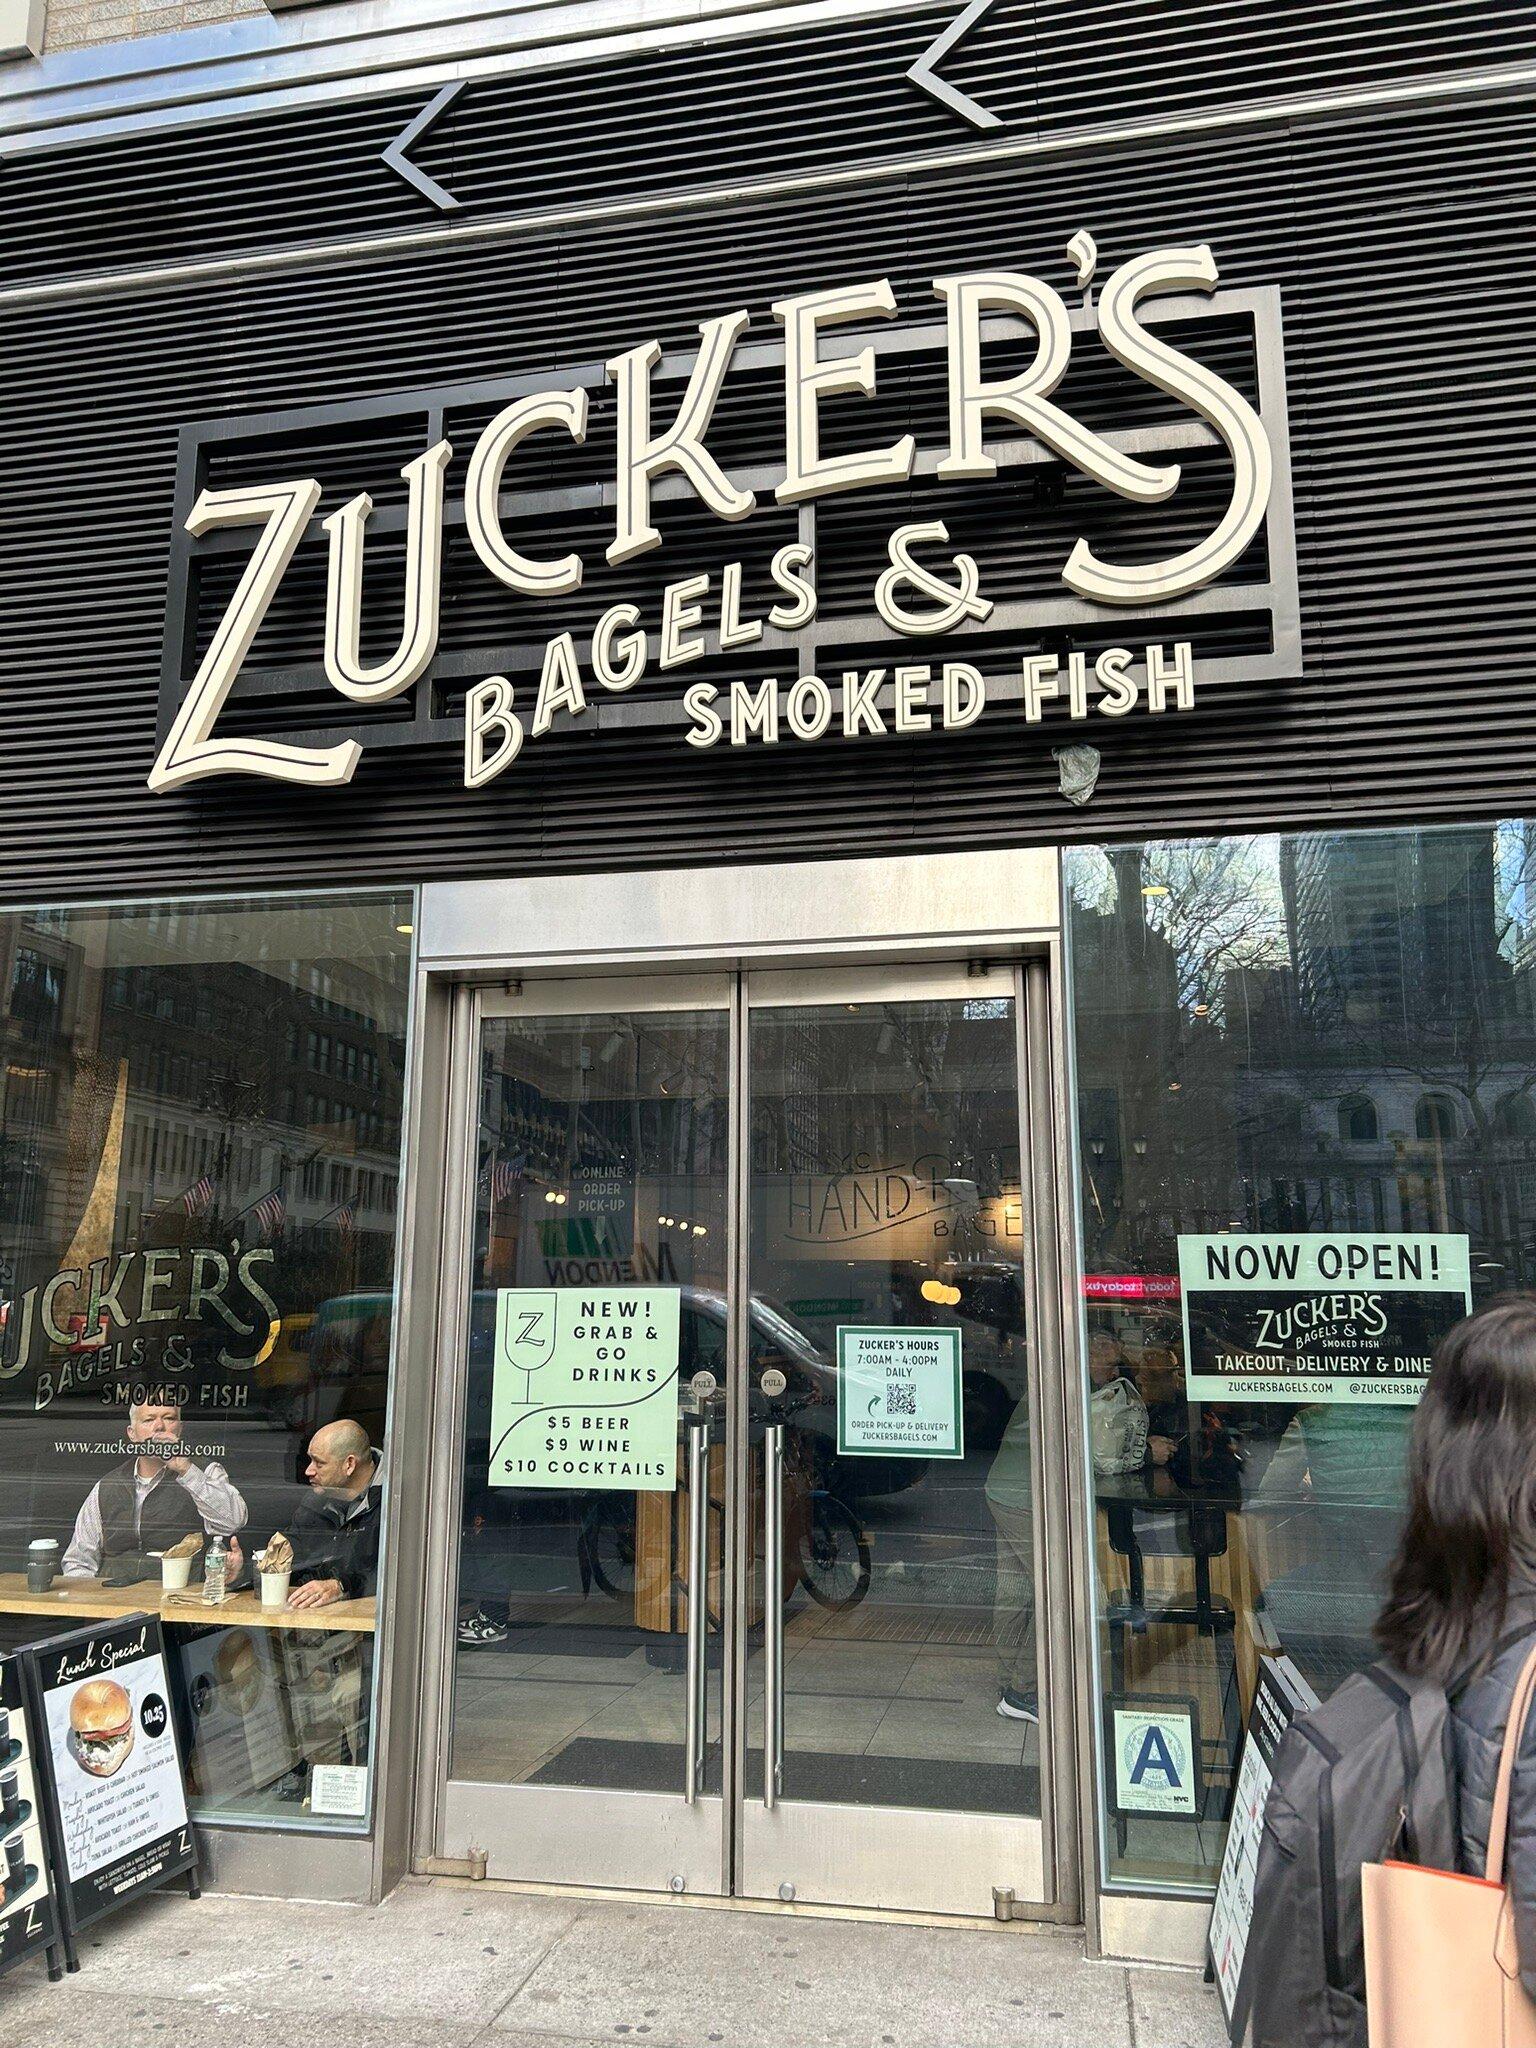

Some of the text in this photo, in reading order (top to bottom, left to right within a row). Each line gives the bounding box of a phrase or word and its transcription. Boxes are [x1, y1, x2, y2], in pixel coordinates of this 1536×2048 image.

[147, 229, 1272, 793] ZUCKER'S
[463, 520, 993, 788] BAGELS &
[684, 642, 1195, 748] SMOKED FISH
[582, 1166, 624, 1178] ONLINE
[583, 1183, 620, 1195] ORDER
[578, 1200, 625, 1212] PICK-UP
[933, 1203, 1023, 1236] BAGE
[1206, 1244, 1439, 1280] NOW OPEN!
[0, 1238, 282, 1379] UCKER'S
[581, 1302, 651, 1318] NEW!
[1255, 1290, 1387, 1349] ZUCKER'S
[516, 1312, 545, 1347] Z
[573, 1326, 658, 1340] GRAB &
[1296, 1323, 1357, 1350] BAGELS &
[858, 1339, 939, 1352] ZUCKER'S HOURS
[1322, 1339, 1357, 1349] SMOKED
[1360, 1339, 1380, 1349] FISH
[596, 1347, 626, 1361] GO
[857, 1354, 892, 1365] 7:00AM
[902, 1355, 938, 1366] 4:00PM
[1215, 1355, 1291, 1373] TAKEOUT,
[1296, 1356, 1369, 1372] DELIVERY
[1376, 1356, 1389, 1373] &
[34, 1334, 195, 1411] BAGELS &
[572, 1368, 657, 1382] DRINKS
[885, 1367, 912, 1378] DAILY
[694, 1380, 712, 1388] PULL
[763, 1379, 783, 1387] PULL
[1228, 1381, 1427, 1396] ZUCKERSBAGELS.COM @ZUCKERSBAG
[101, 1382, 249, 1407] SMOKED FISH
[548, 1416, 630, 1430] $5 BEER
[851, 1420, 949, 1432] ORDER PICK-UP & DELIVERY
[862, 1431, 938, 1442] ZUCKERSBAGELS.COM
[54, 1439, 226, 1460] www.zuckersbagels.com
[546, 1438, 630, 1452] $9 WINE
[504, 1459, 665, 1476] $10 COCKTAILS
[57, 1626, 147, 1684] Lunch Special
[143, 1705, 164, 1725] 10.25
[1129, 1726, 1182, 1788] A
[178, 1831, 191, 1852] Z
